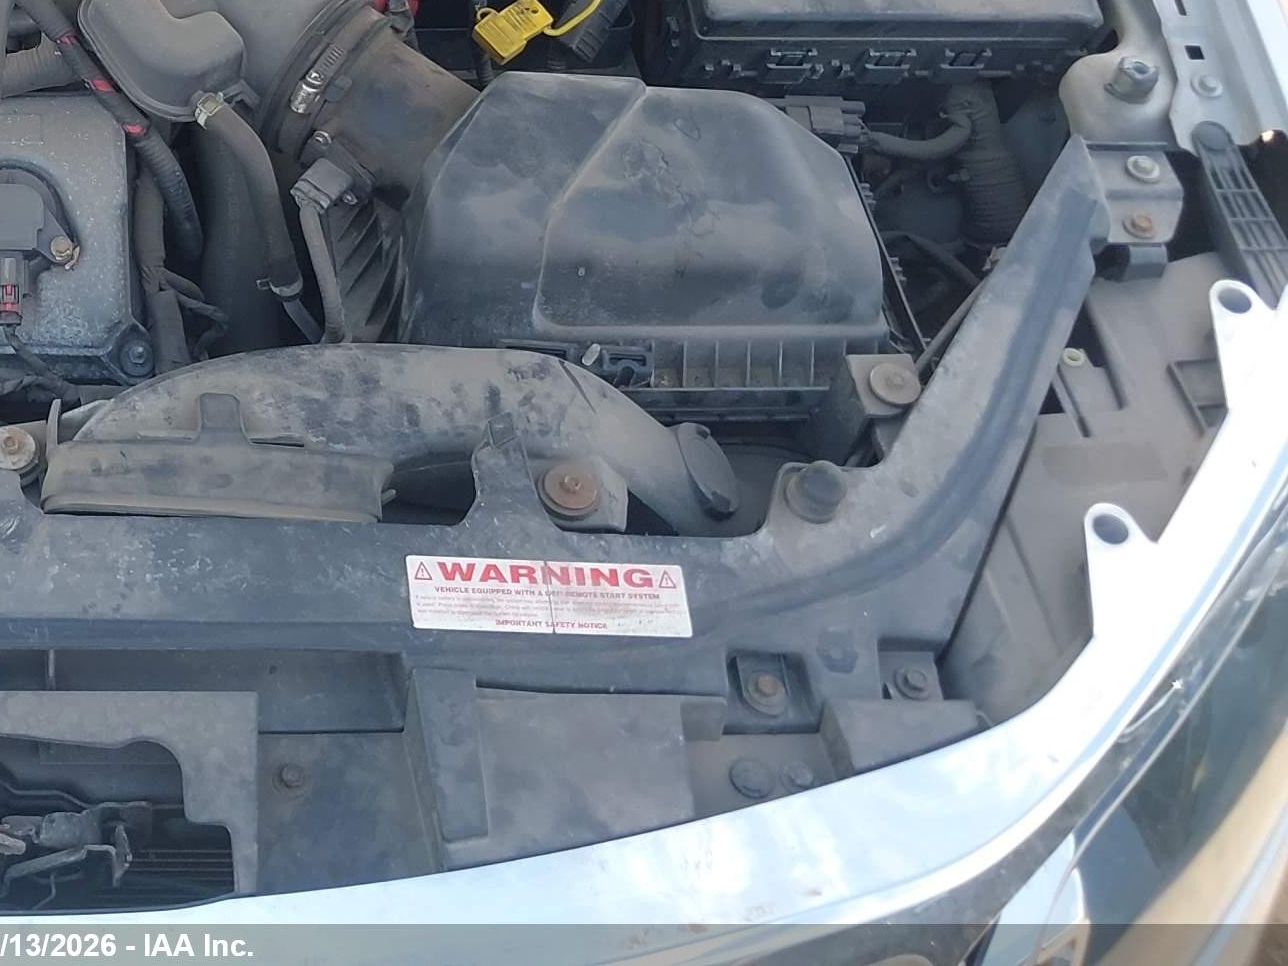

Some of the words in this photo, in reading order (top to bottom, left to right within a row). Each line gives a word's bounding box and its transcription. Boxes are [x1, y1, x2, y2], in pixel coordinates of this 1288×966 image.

[437, 561, 654, 588] WARNING
[434, 585, 470, 594] VEHICLE
[472, 587, 513, 595] EQUIPPED
[565, 591, 597, 599] REMOTE
[495, 619, 543, 628] IMPORTANT
[545, 620, 576, 629] SAFETY
[578, 621, 608, 630] NOTICE
